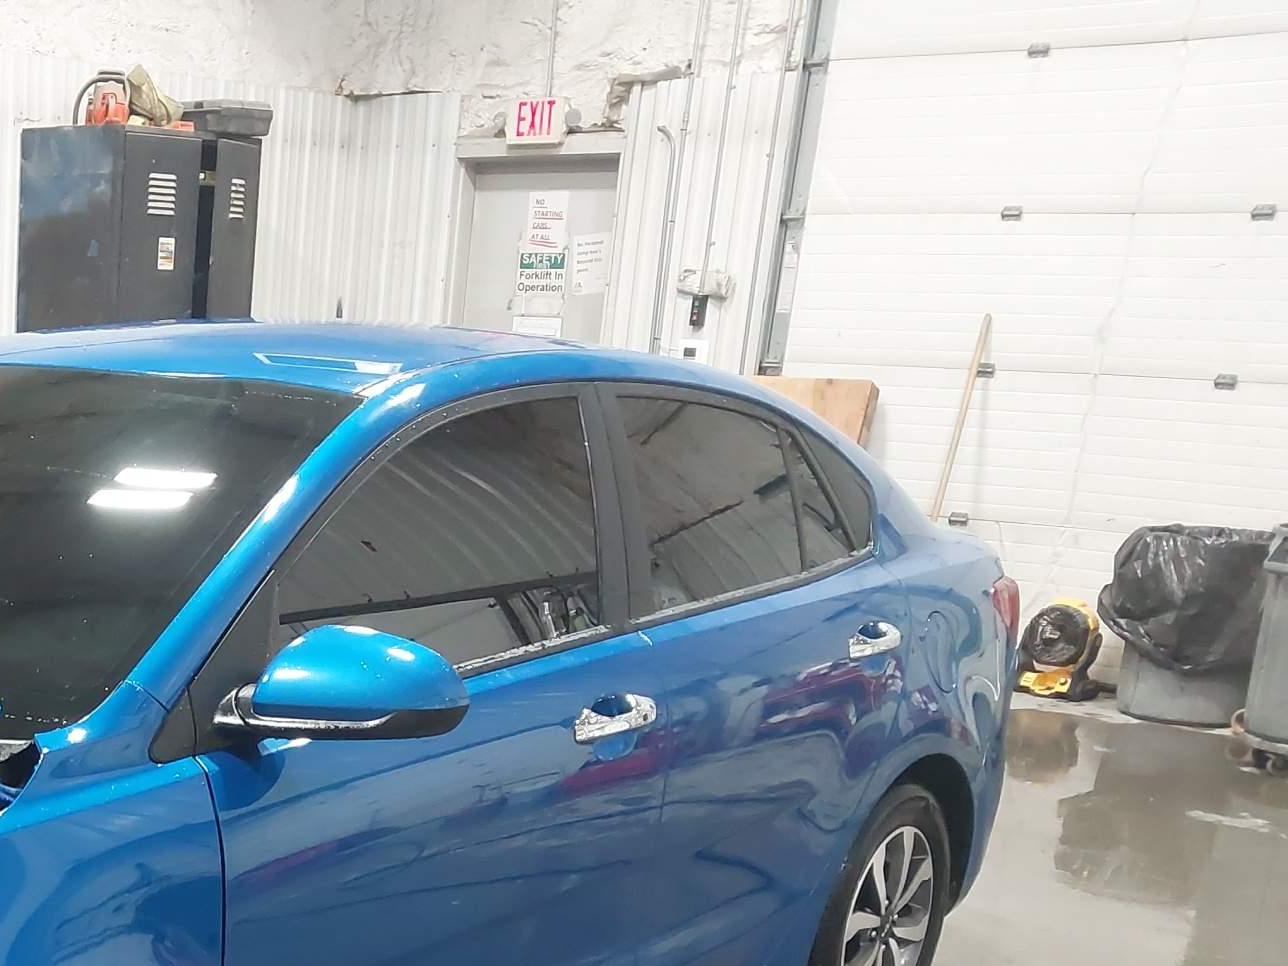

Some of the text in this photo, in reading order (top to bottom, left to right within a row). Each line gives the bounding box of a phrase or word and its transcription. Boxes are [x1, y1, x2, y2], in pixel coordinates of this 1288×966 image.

[516, 100, 556, 136] EXIT
[522, 253, 563, 264] SAFETY
[519, 270, 563, 280] Forklift In
[517, 281, 563, 294] Operation
